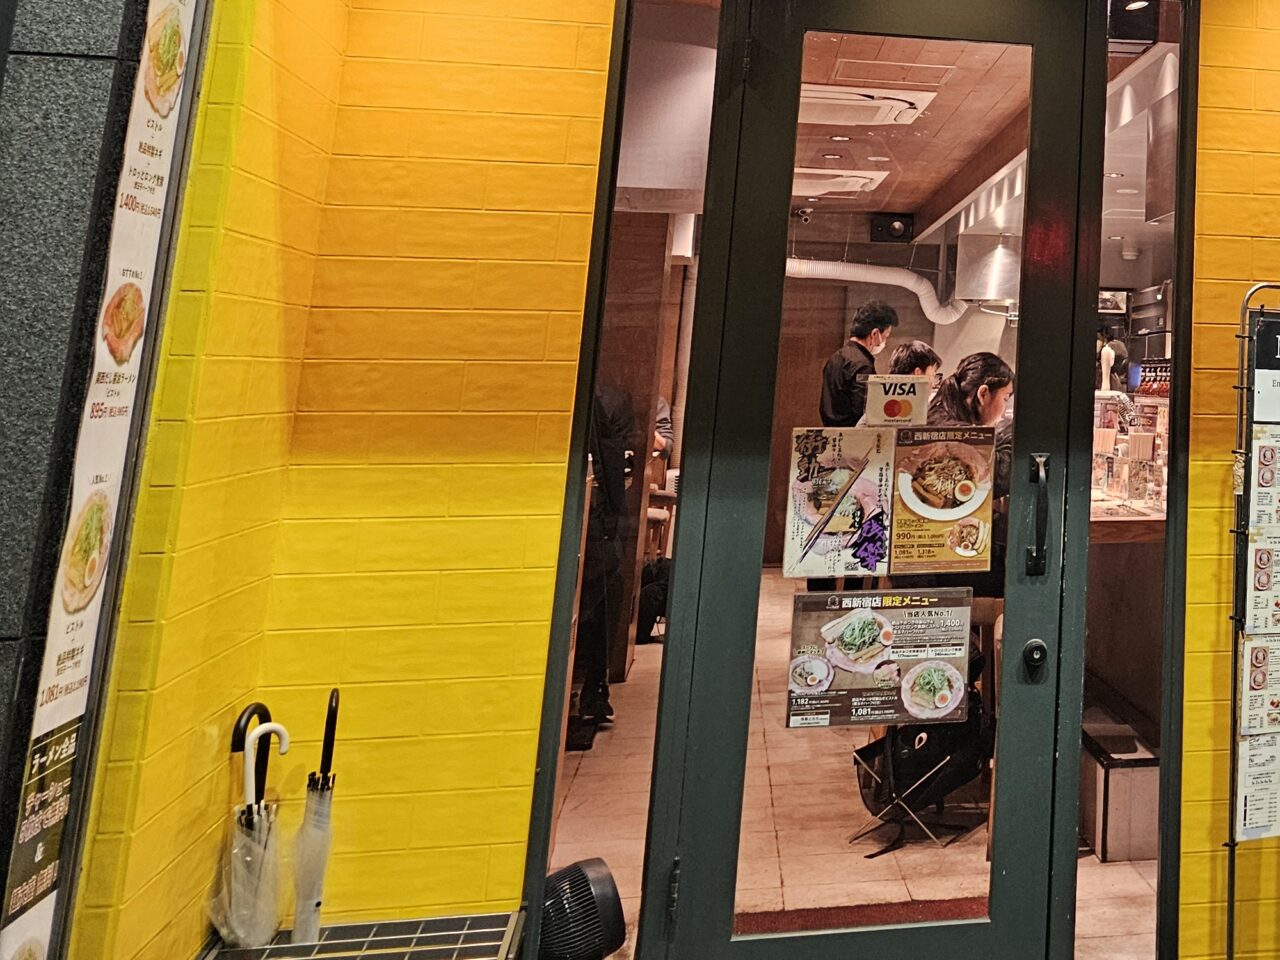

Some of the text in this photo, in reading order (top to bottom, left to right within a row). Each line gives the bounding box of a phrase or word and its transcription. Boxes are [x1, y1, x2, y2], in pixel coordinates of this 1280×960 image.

[880, 383, 917, 396] VISA
[914, 431, 993, 441] 西新宿店限定メニュー
[32, 732, 77, 775] ラーメン全品
